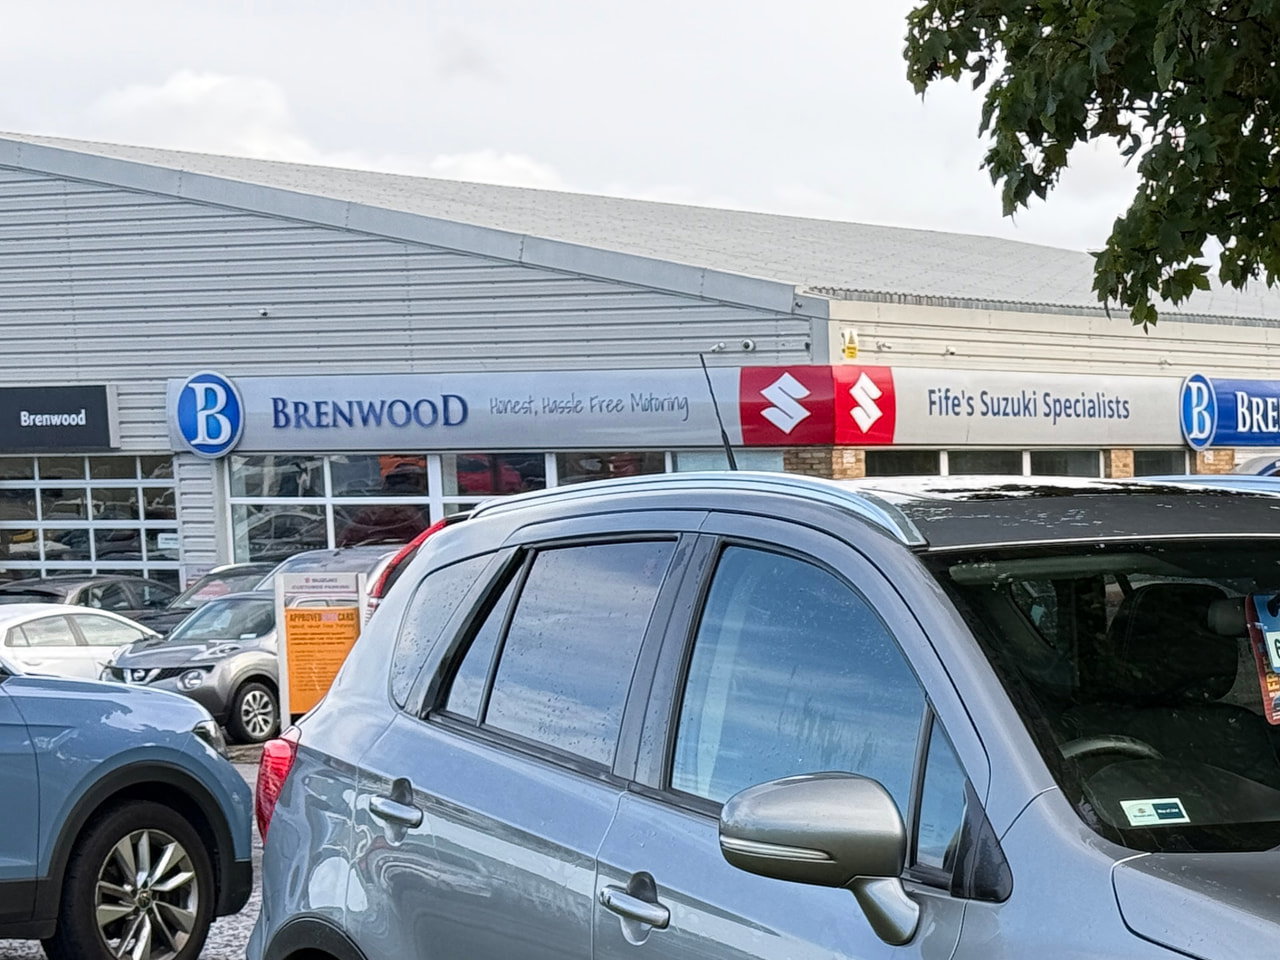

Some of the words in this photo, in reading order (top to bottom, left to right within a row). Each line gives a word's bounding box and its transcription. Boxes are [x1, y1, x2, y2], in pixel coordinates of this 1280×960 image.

[20, 408, 86, 427] Brenwood
[188, 382, 232, 446] B
[271, 393, 469, 431] BRENWOOD
[490, 394, 538, 416] Honest,
[541, 392, 584, 415] Hassle
[589, 395, 625, 414] Free
[630, 392, 690, 422] Motoring
[928, 388, 975, 417] Fife's
[980, 391, 1037, 418] Suzuki
[1043, 396, 1130, 426] Specialists
[1188, 381, 1211, 441] B
